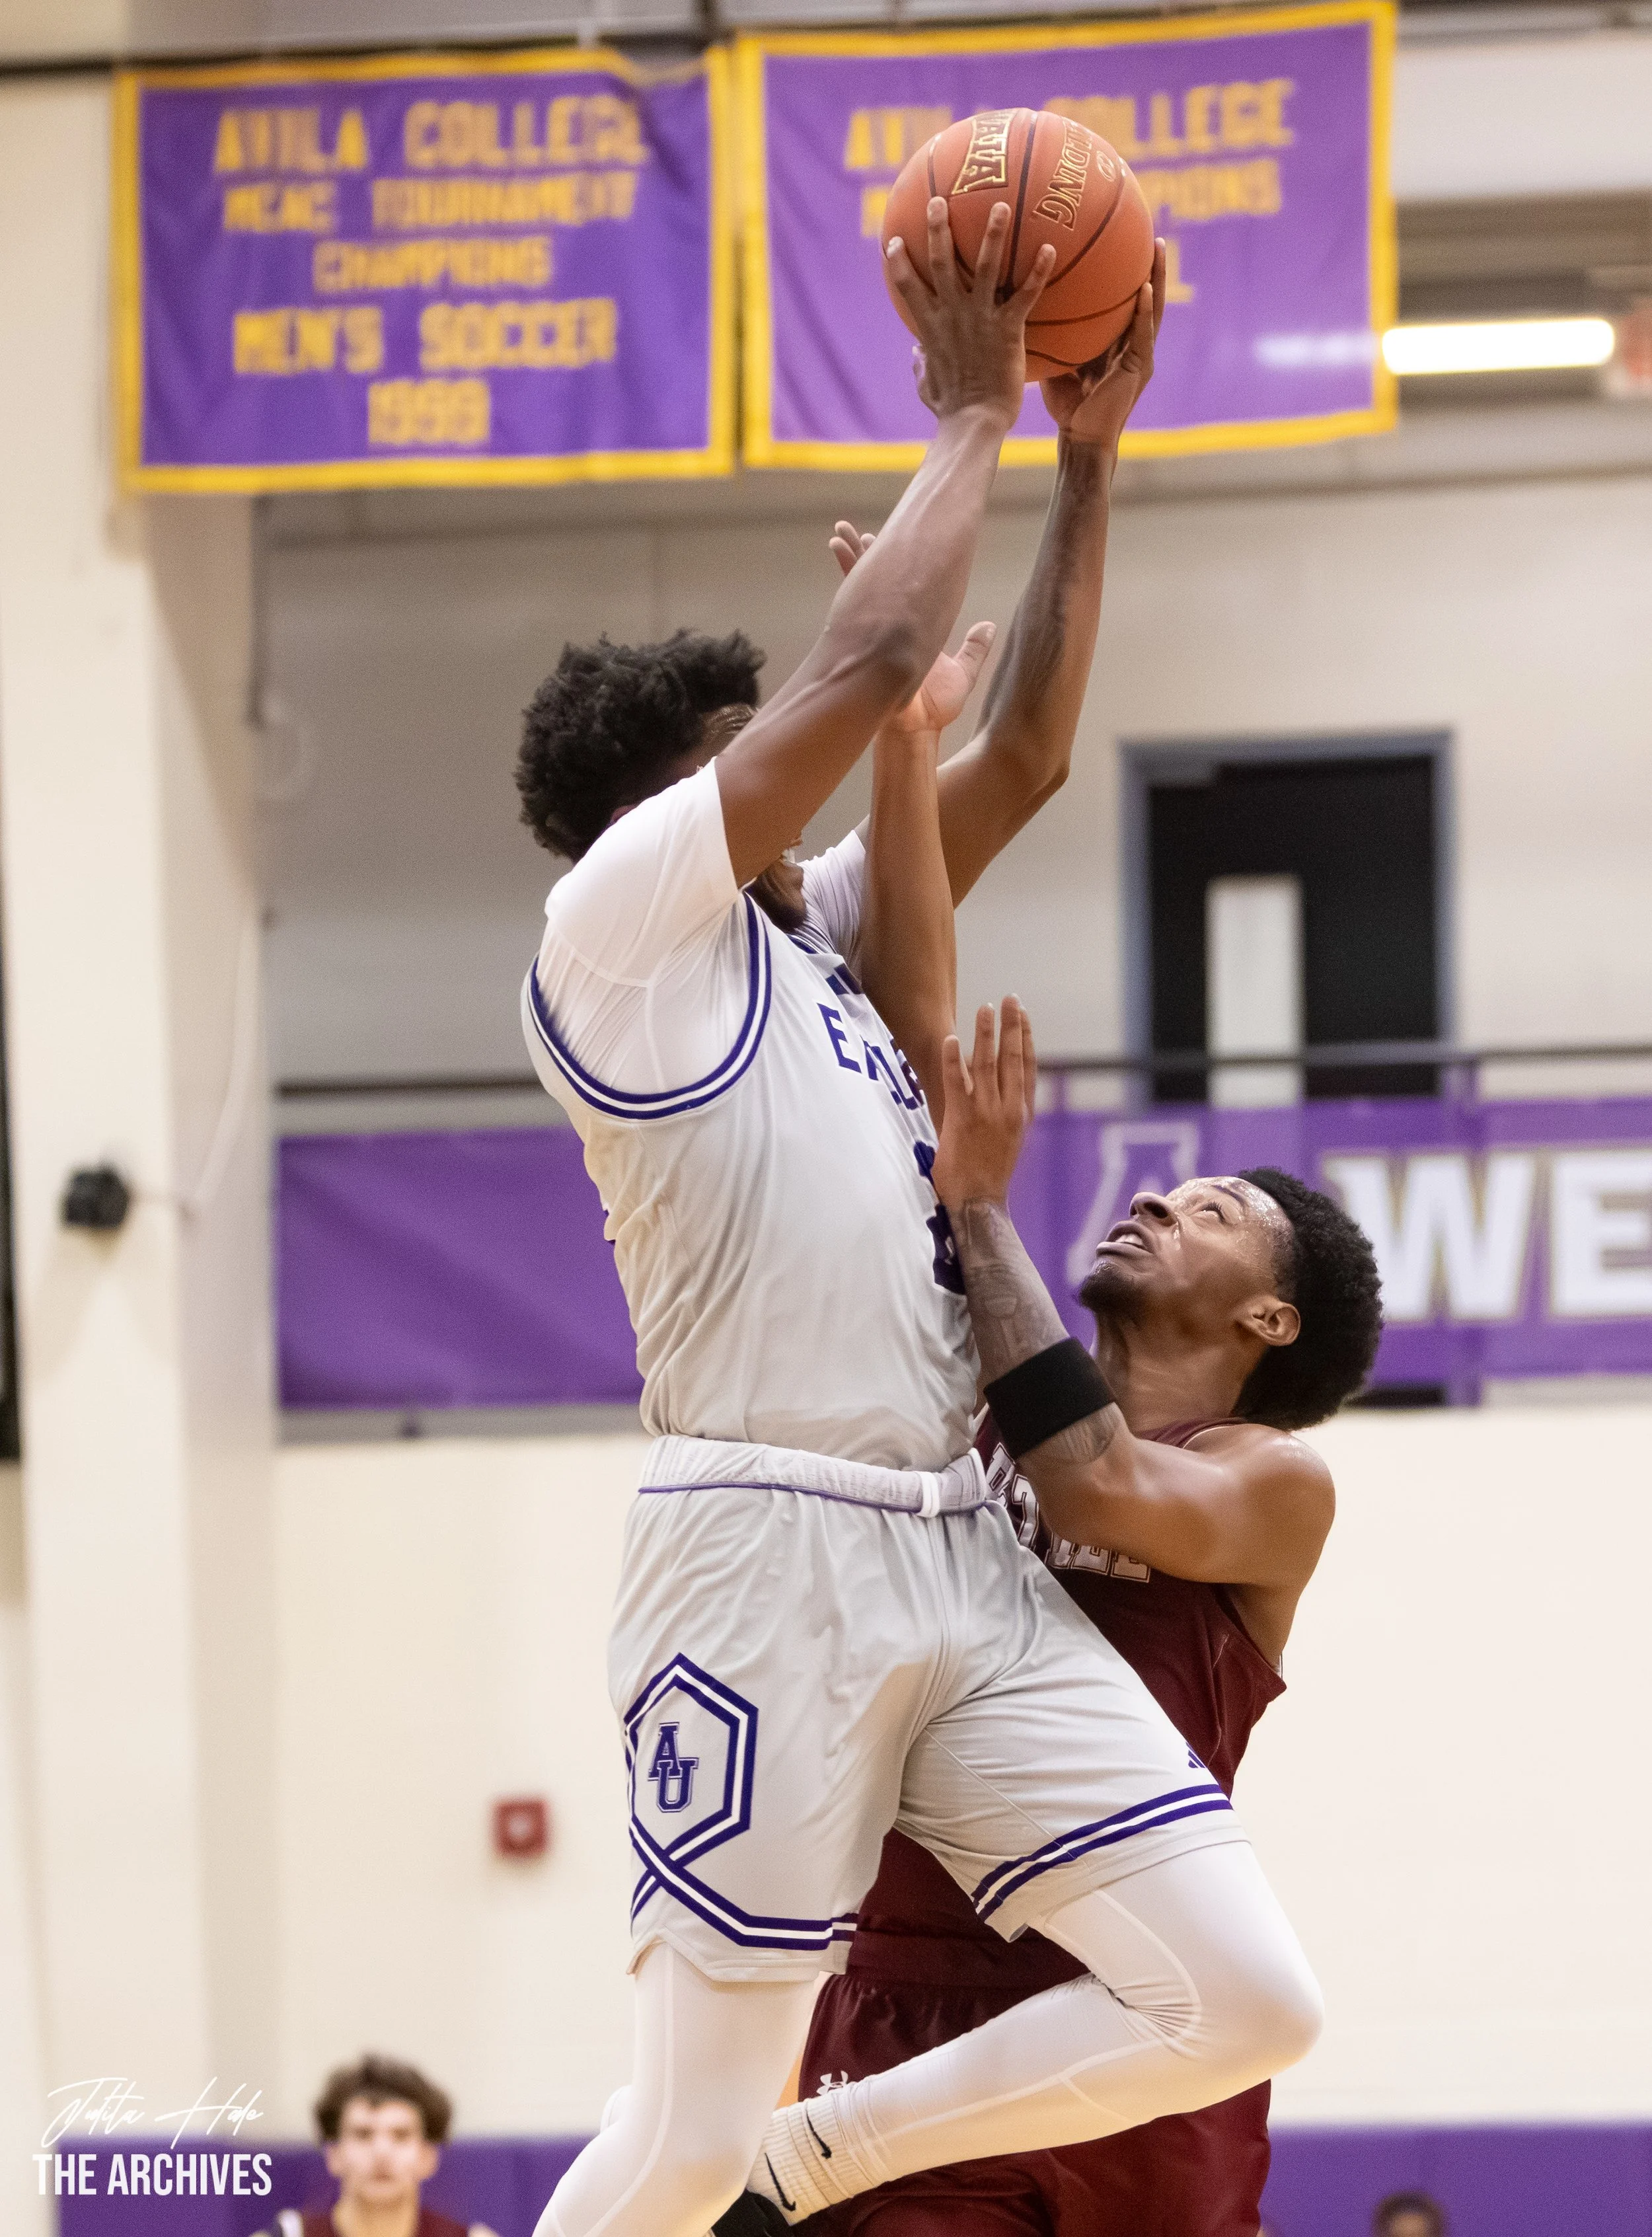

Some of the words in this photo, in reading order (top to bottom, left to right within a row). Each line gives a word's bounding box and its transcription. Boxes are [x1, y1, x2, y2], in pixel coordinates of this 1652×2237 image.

[215, 108, 368, 172] AVILA
[313, 235, 553, 293] CHAMPIONS
[234, 307, 383, 374] MEN'S
[419, 297, 618, 369] SOCCER
